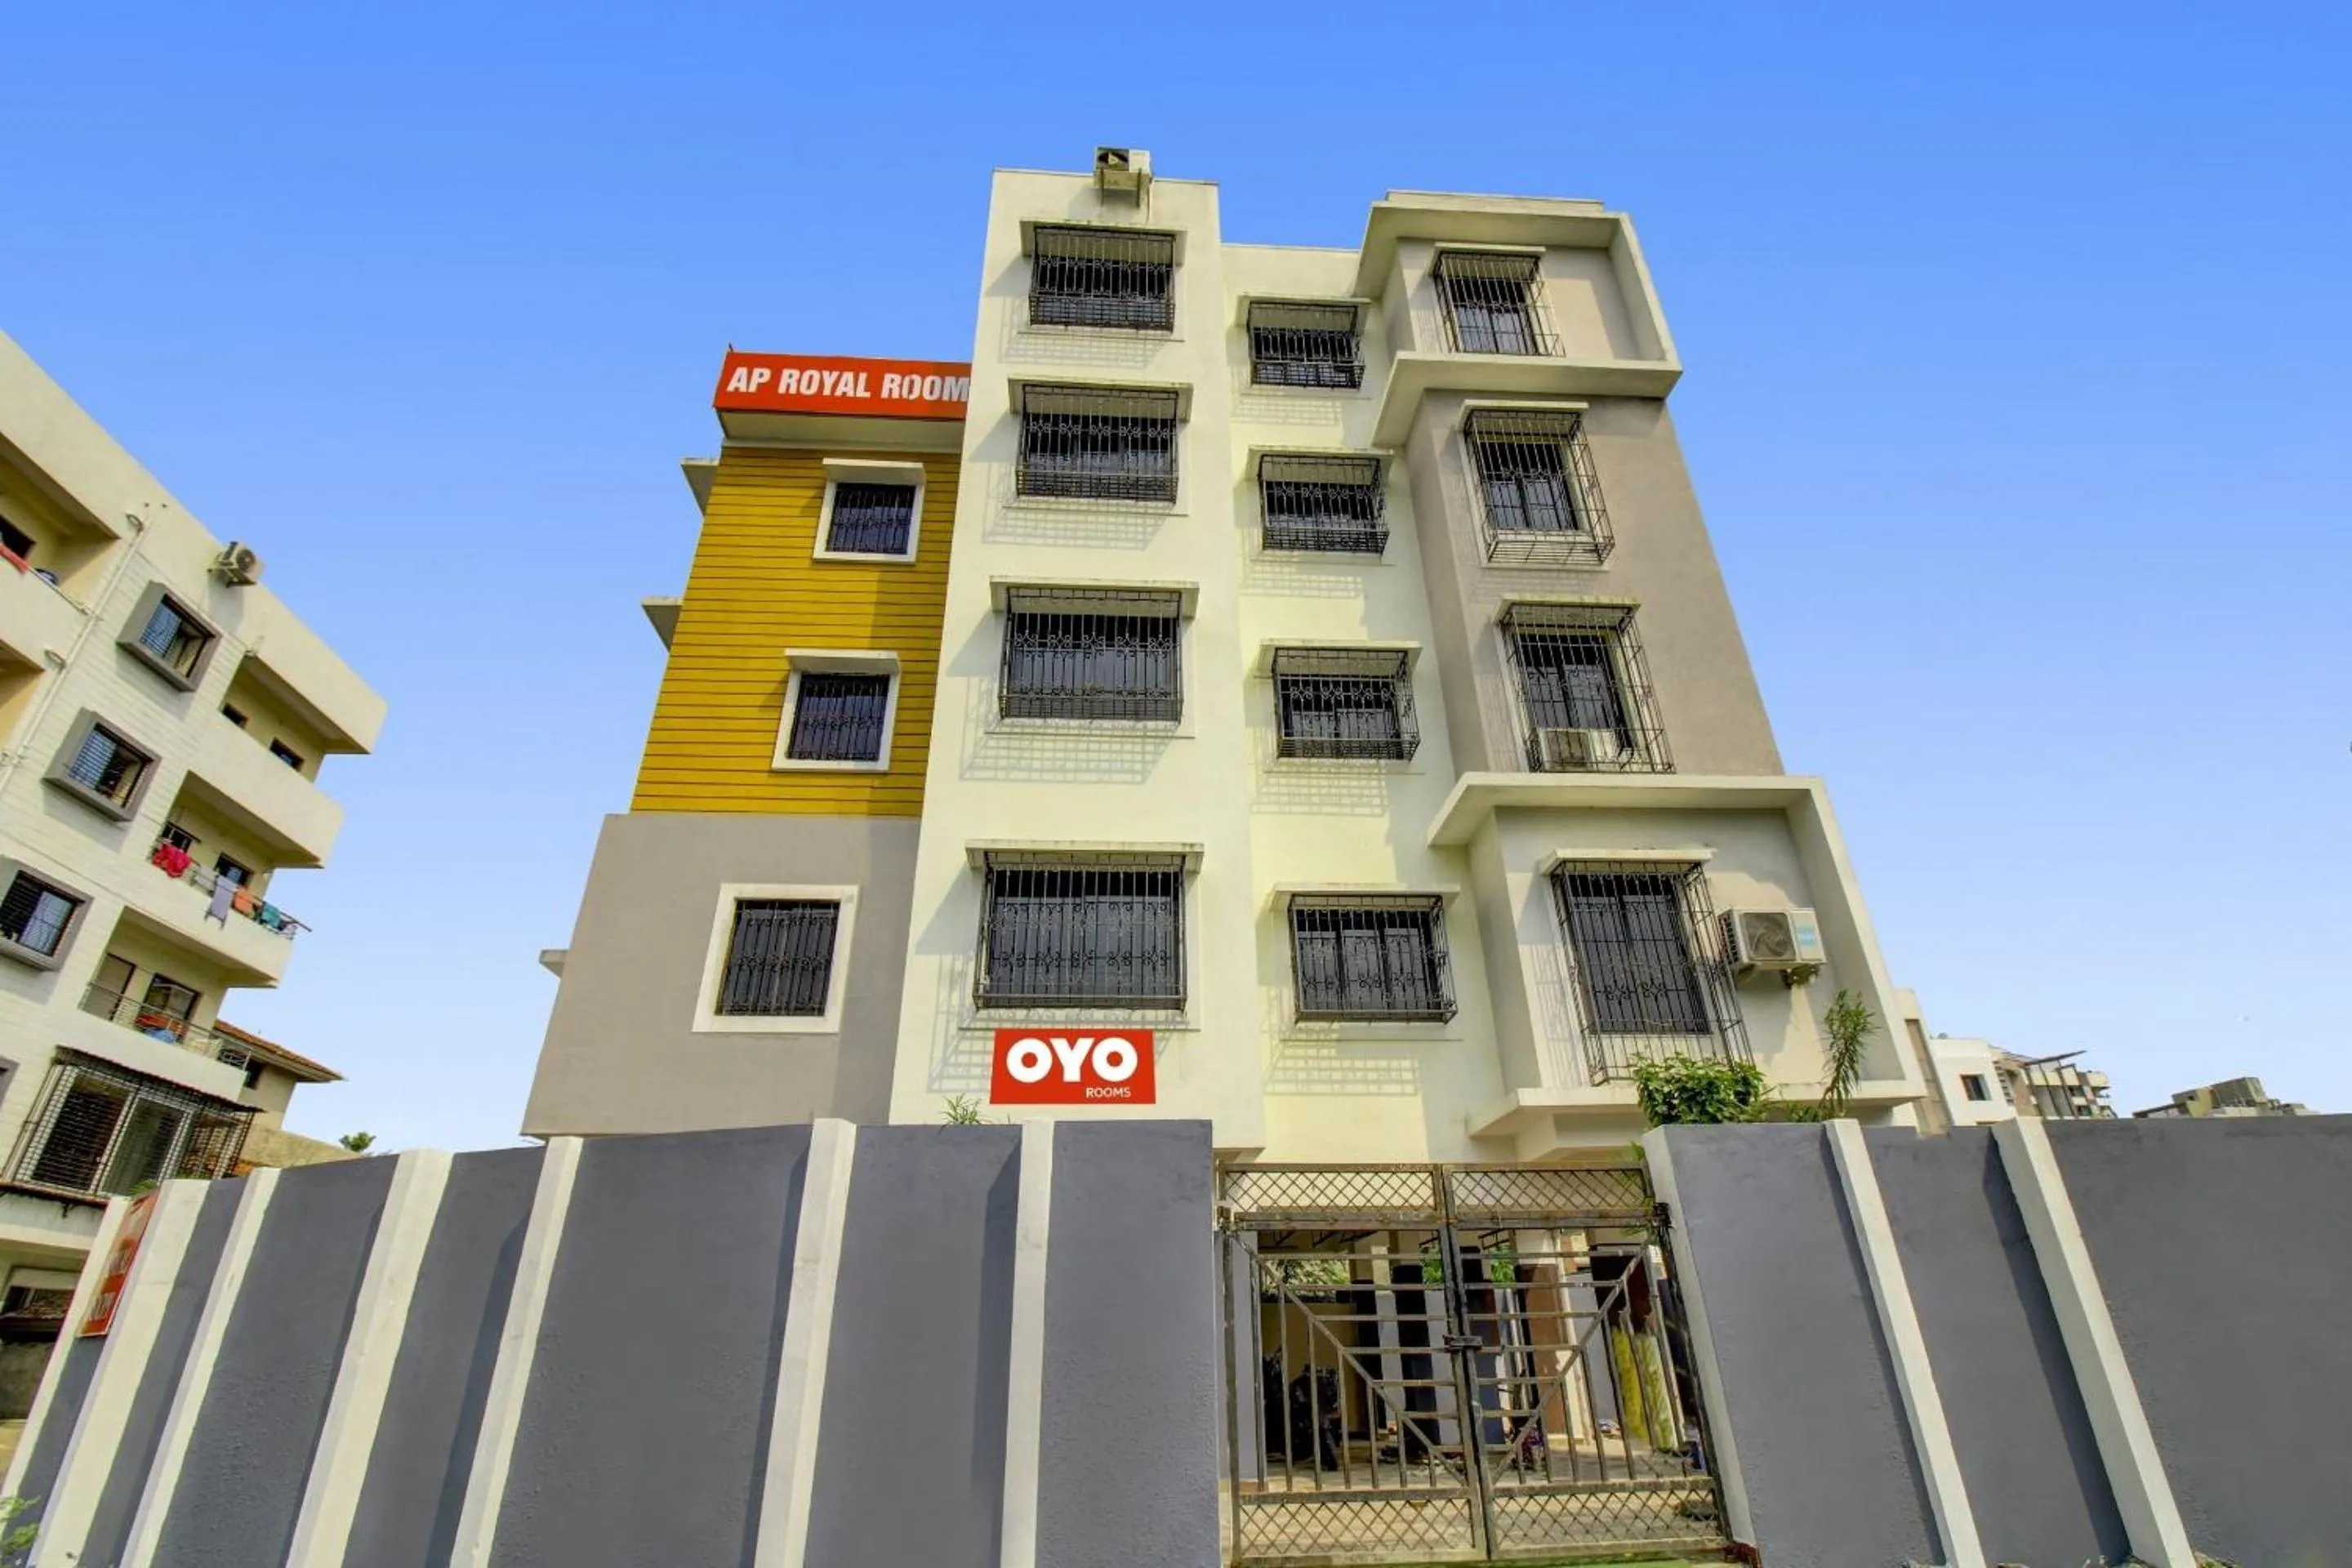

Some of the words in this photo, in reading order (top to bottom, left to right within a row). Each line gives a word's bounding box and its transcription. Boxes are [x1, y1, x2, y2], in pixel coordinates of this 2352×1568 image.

[727, 367, 772, 393] AP
[778, 368, 871, 398] ROYAL
[880, 373, 970, 402] ROOM
[1006, 1037, 1138, 1083] OYO
[1085, 1087, 1132, 1098] ROOMS
